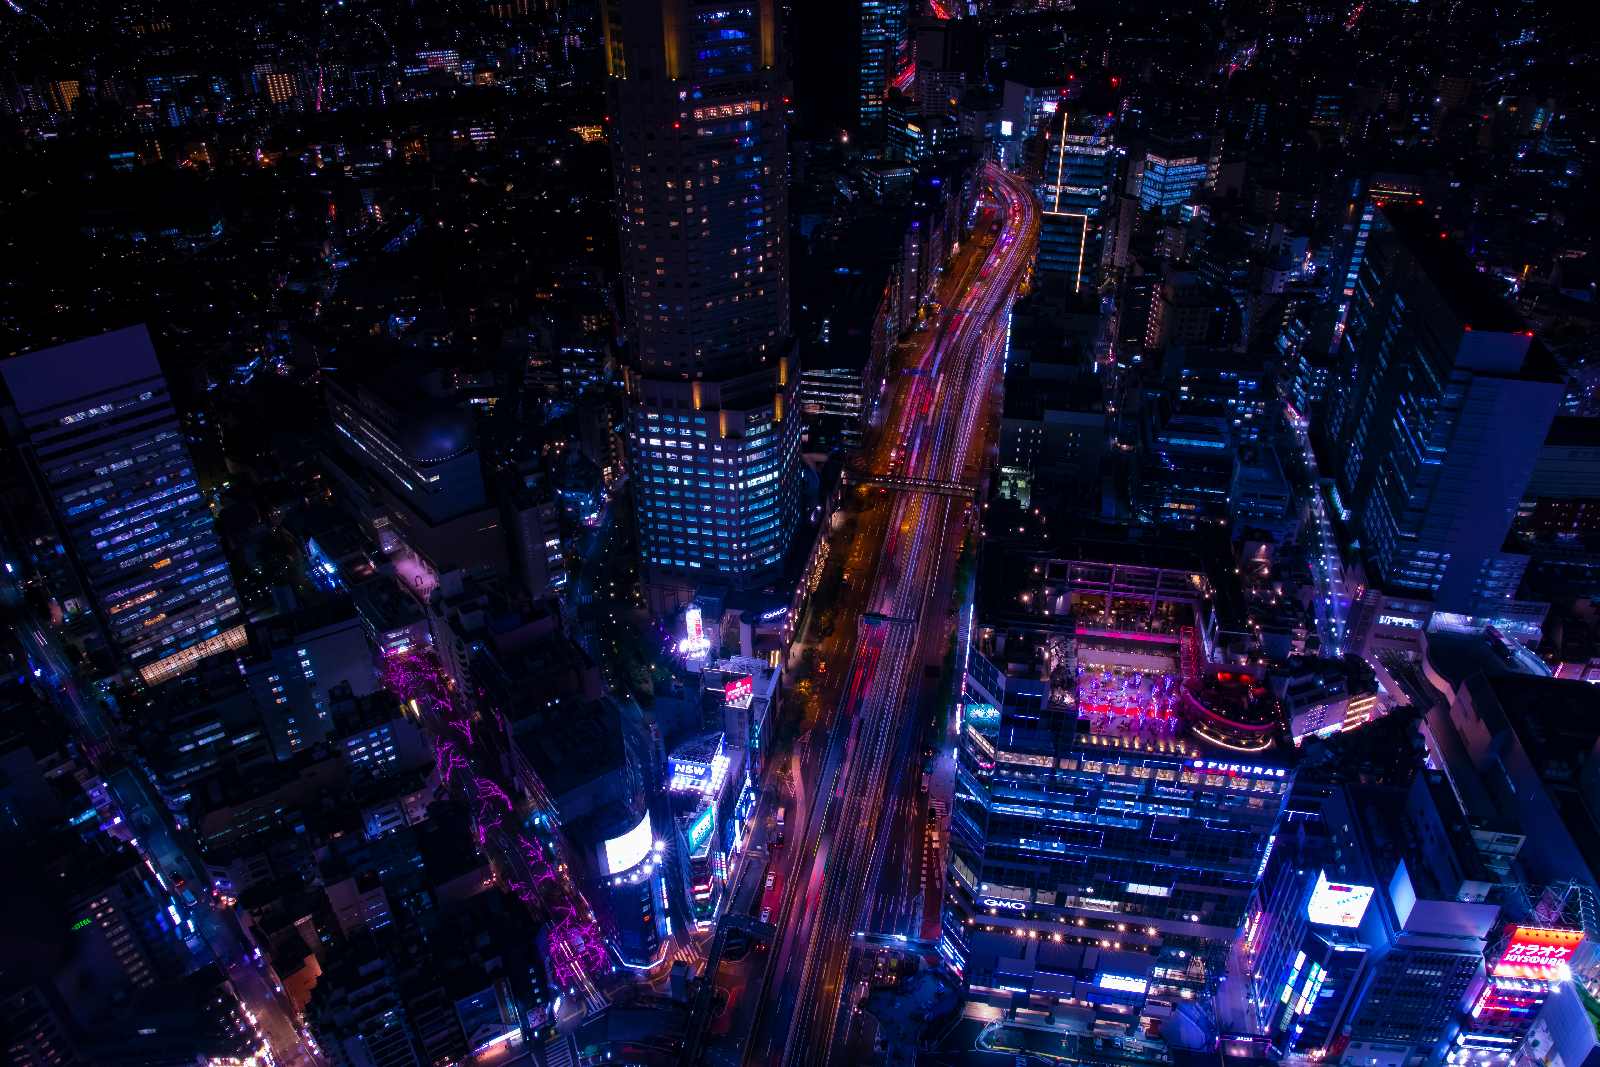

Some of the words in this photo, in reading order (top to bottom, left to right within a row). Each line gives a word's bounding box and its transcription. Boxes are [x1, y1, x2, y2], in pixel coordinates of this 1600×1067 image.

[1208, 762, 1285, 777] FUKURAS
[984, 899, 1026, 910] GMO
[1508, 942, 1572, 958] カラオケ
[1504, 953, 1566, 966] JOYSOUND
